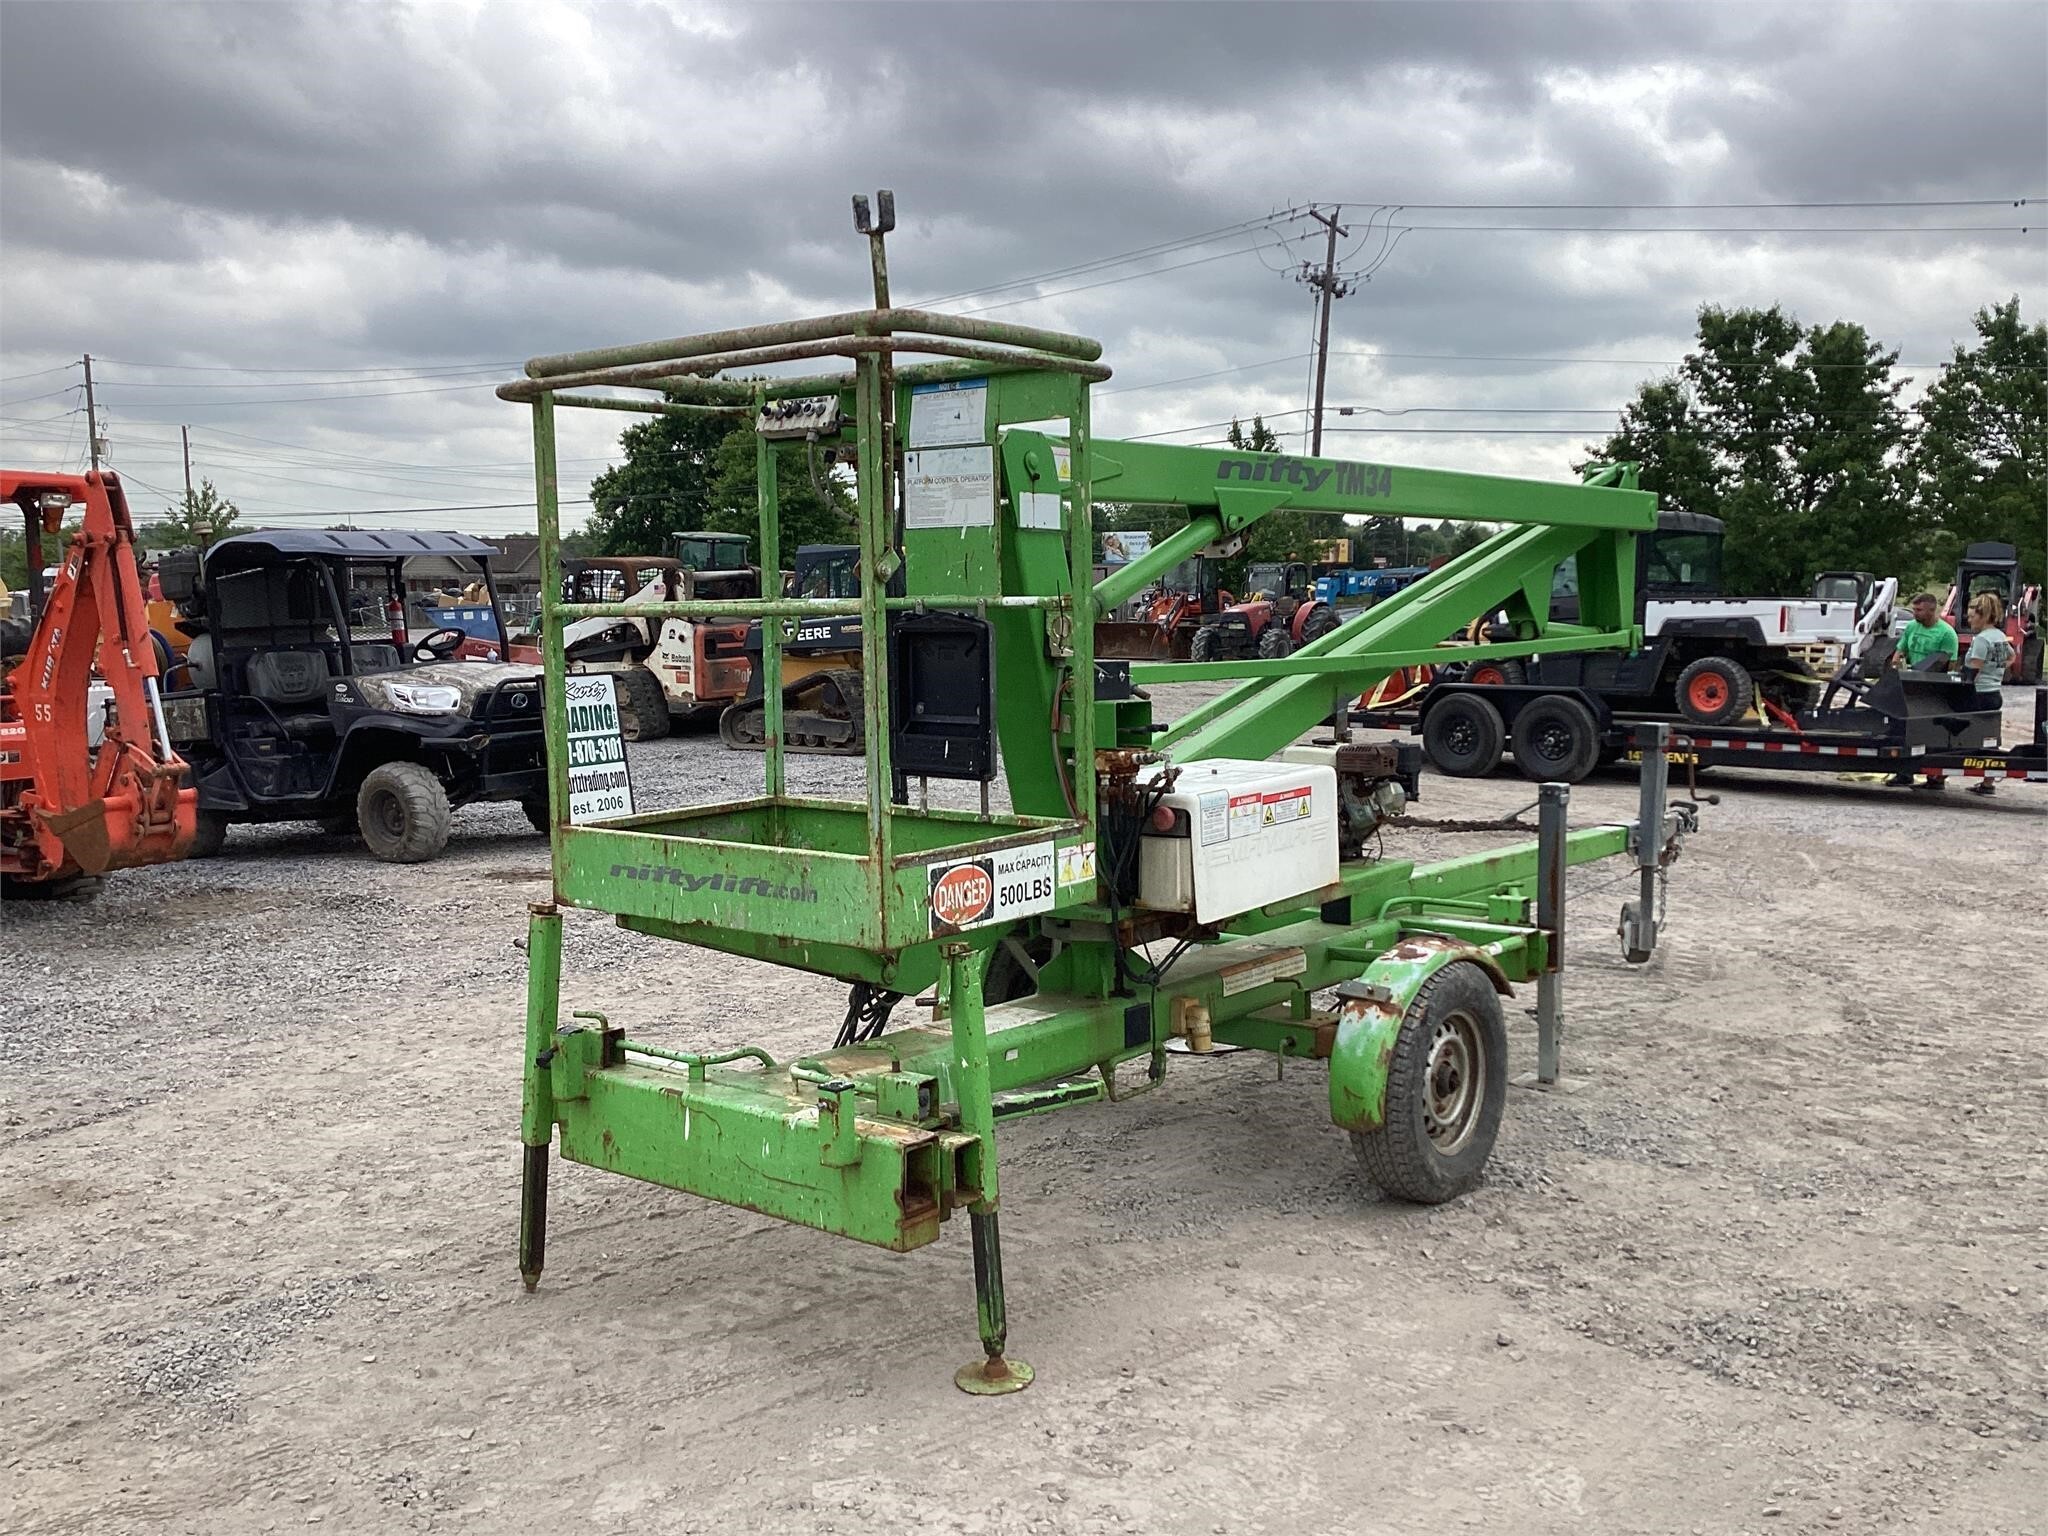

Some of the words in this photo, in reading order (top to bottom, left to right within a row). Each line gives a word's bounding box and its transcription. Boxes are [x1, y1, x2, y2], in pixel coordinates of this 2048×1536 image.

[934, 477, 960, 485] CONTROL
[1217, 455, 1332, 492] nifty
[1335, 462, 1393, 498] TM34
[41, 627, 62, 690] KUBTA
[671, 653, 692, 664] Bobcat
[565, 680, 608, 702] Kurtz
[35, 703, 51, 723] 55
[568, 703, 614, 734] ADING
[1963, 757, 2007, 769] BigTex
[573, 800, 595, 815] est.
[596, 795, 624, 812] 2006
[998, 861, 1015, 875] MAX
[1016, 854, 1052, 872] CAPACITY
[610, 863, 818, 903] niftylift.com
[1000, 876, 1052, 907] 500LBS
[938, 877, 987, 913] DANGER
